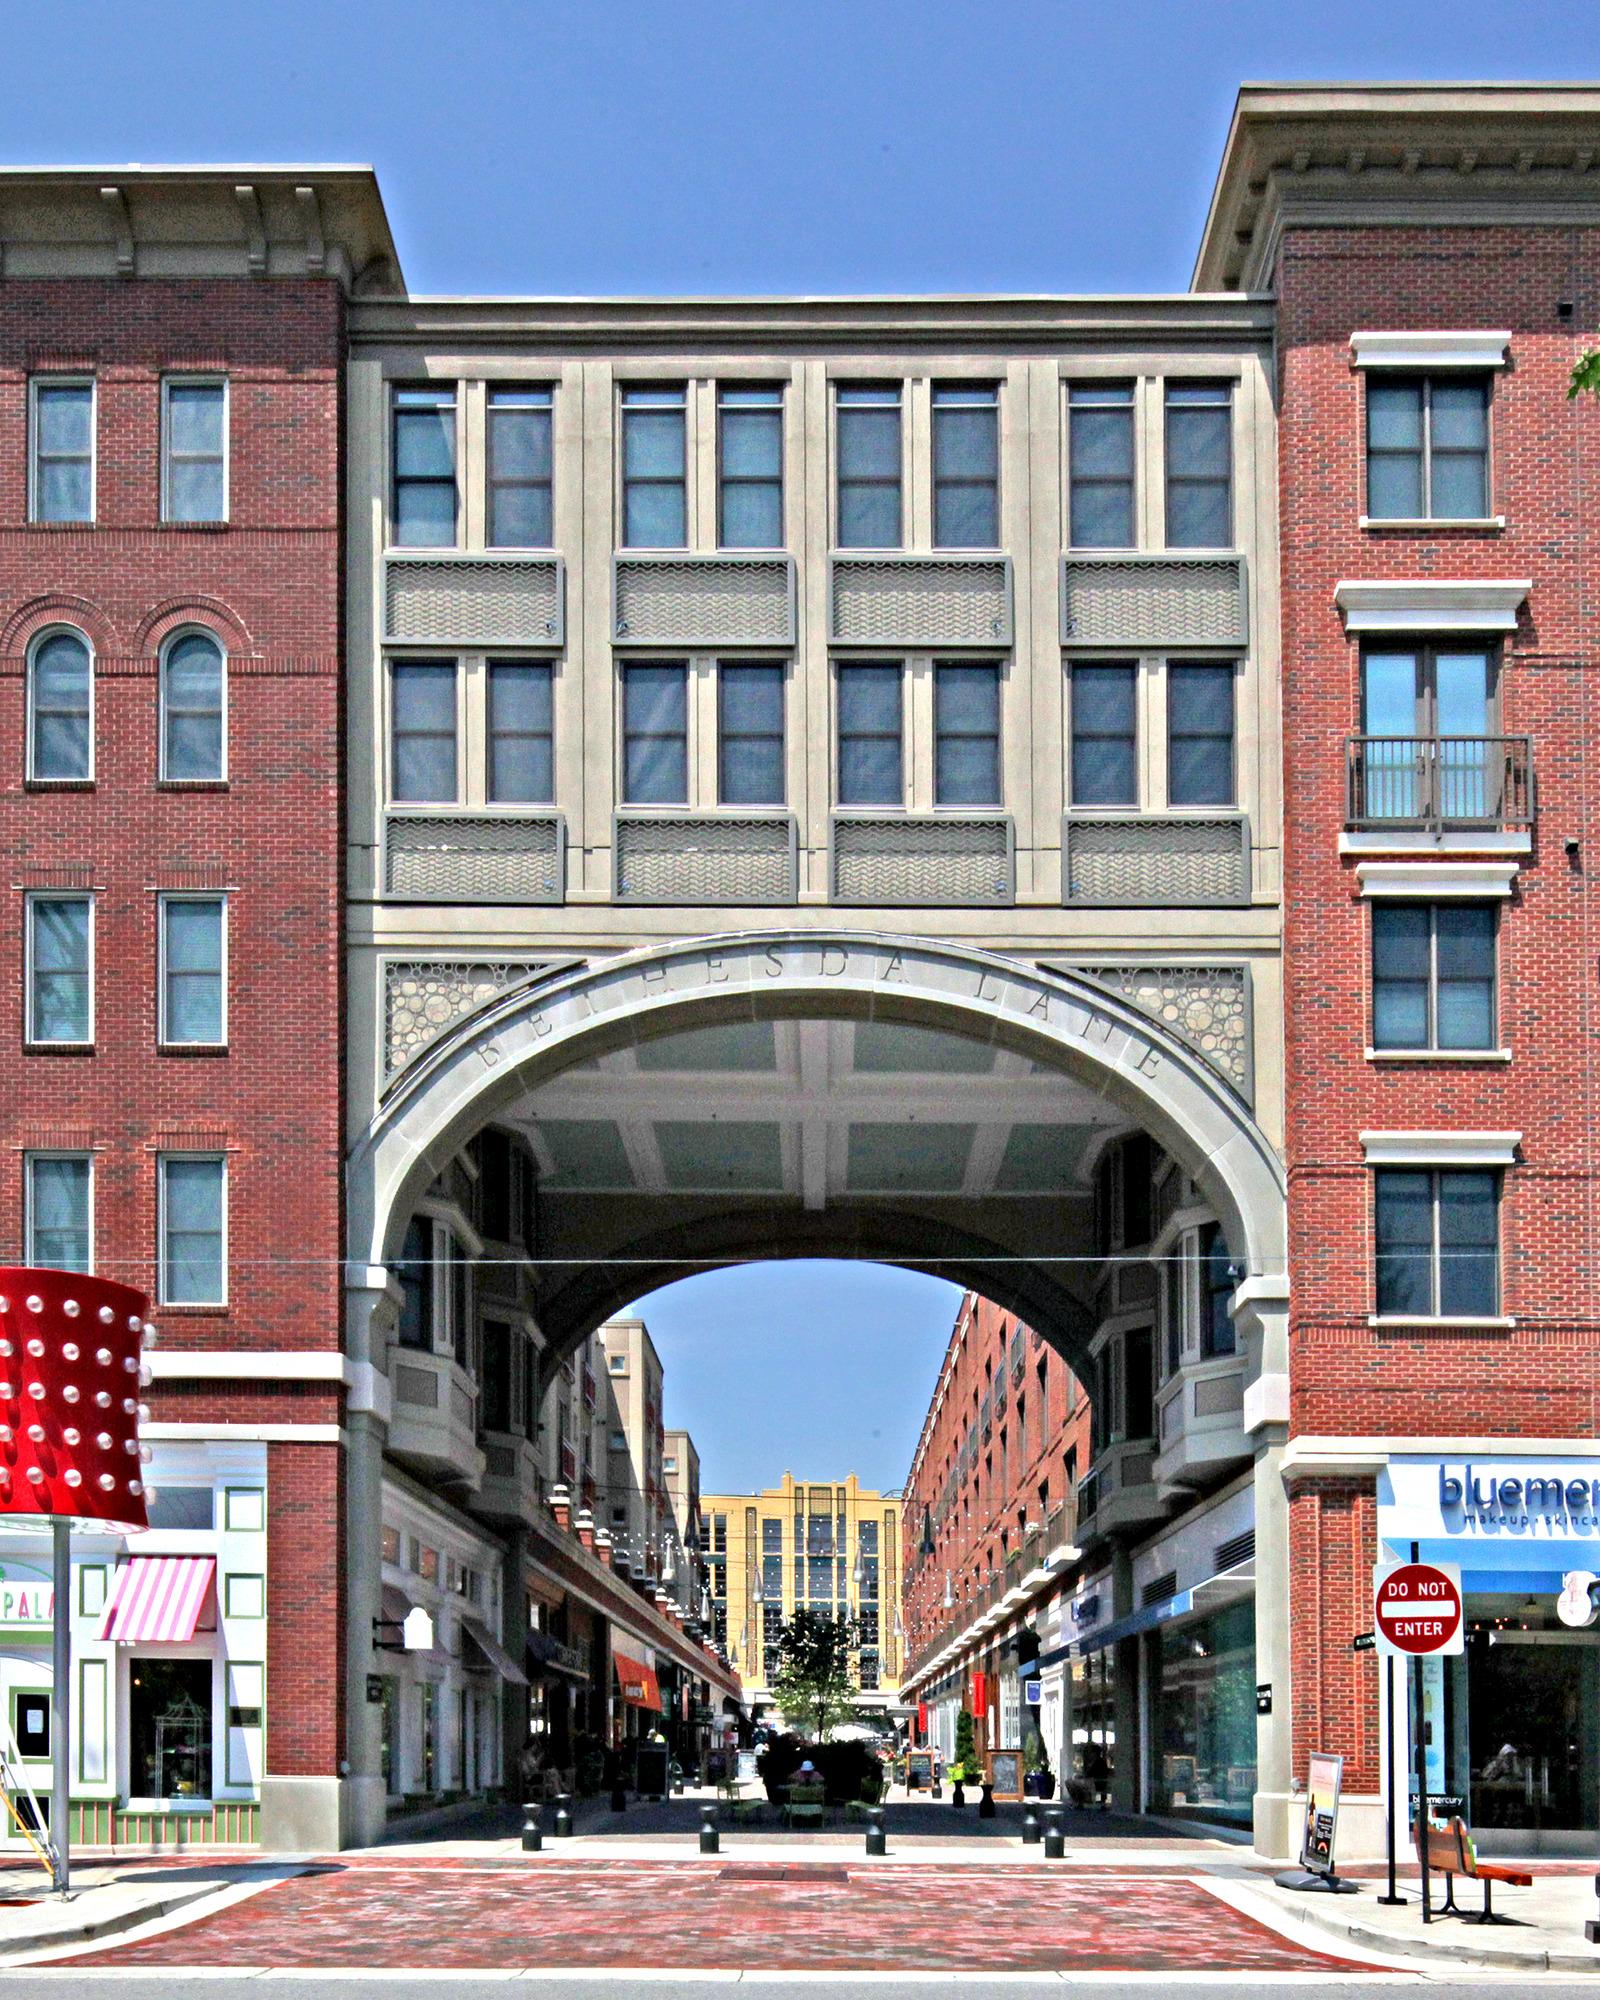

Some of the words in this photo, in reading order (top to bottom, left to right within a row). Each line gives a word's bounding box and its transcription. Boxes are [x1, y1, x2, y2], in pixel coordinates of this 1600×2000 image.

[475, 944, 910, 1071] BETHESDA
[973, 967, 1162, 1081] LANE
[1464, 1513, 1530, 1528] makeup
[1388, 1583, 1408, 1597] DO
[1418, 1582, 1447, 1596] NOT
[1395, 1622, 1443, 1637] ENTER
